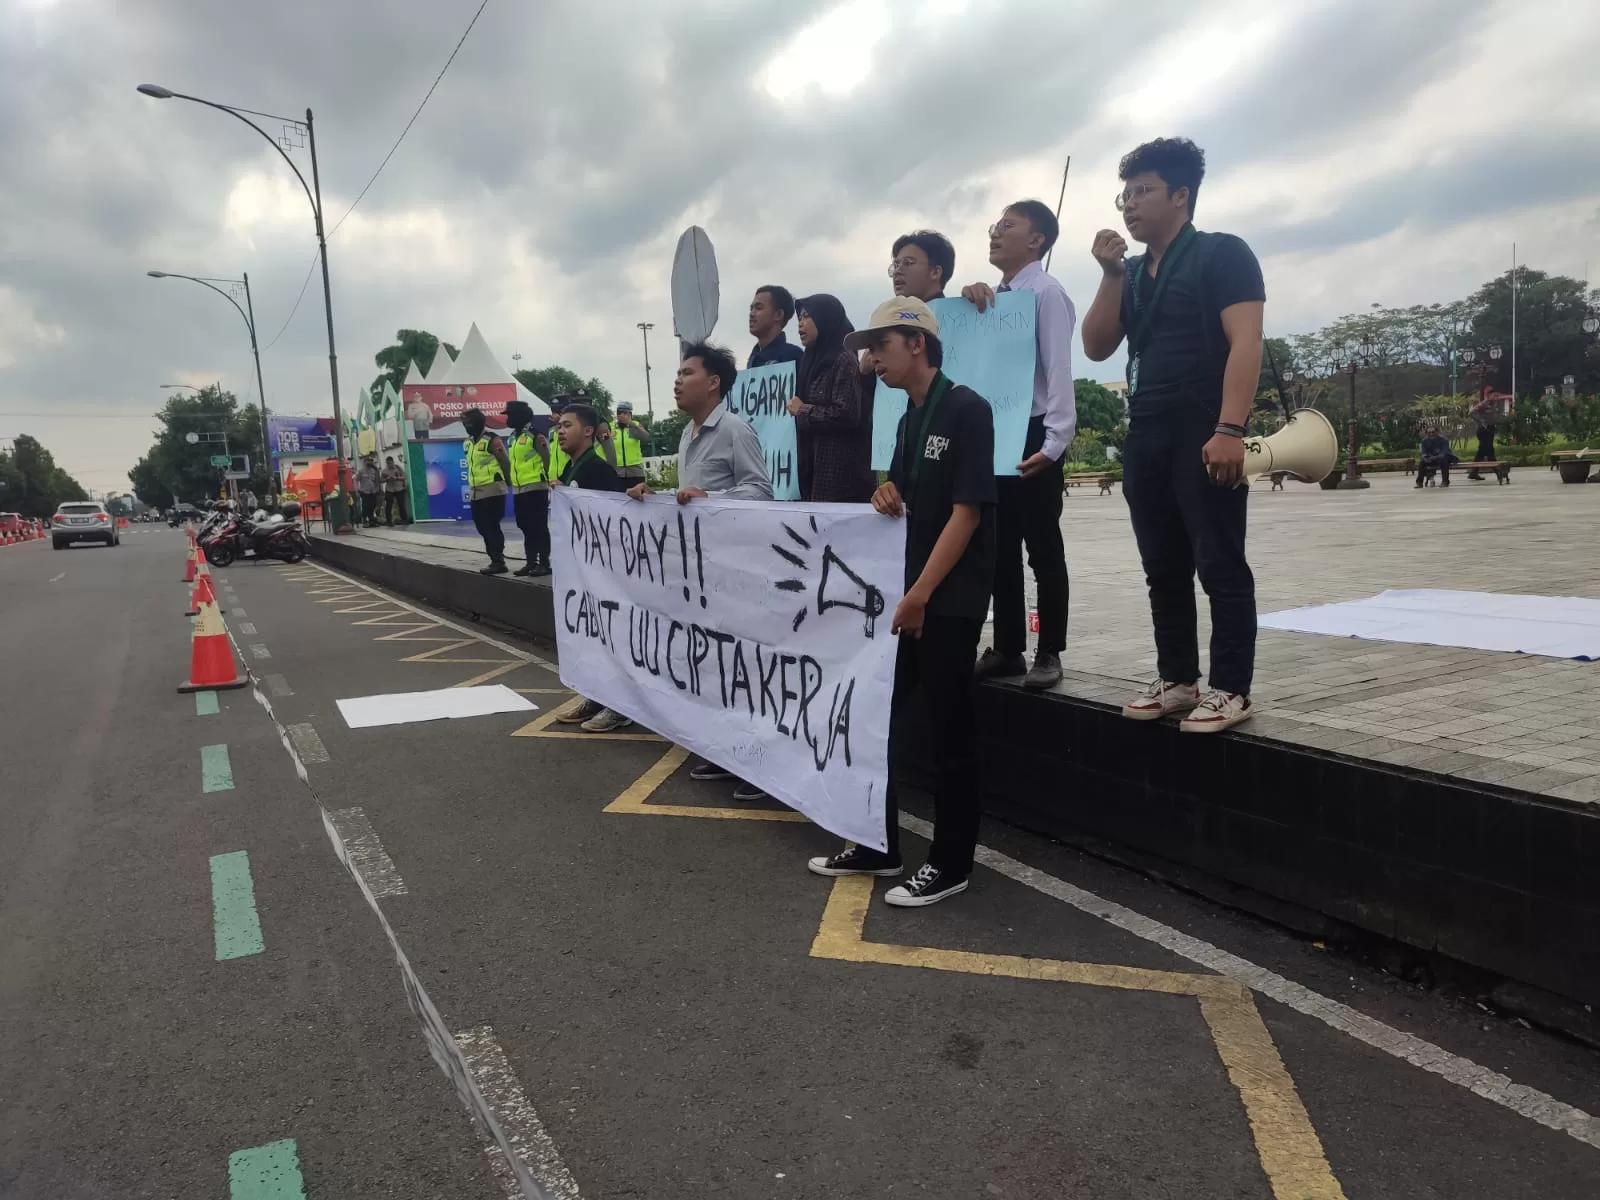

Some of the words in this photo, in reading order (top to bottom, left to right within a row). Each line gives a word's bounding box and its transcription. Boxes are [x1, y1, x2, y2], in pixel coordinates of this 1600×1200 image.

[433, 402, 464, 411] POSKO
[466, 401, 507, 410] KESEHATA
[571, 507, 613, 572] MAY
[564, 588, 620, 654] CABUT
